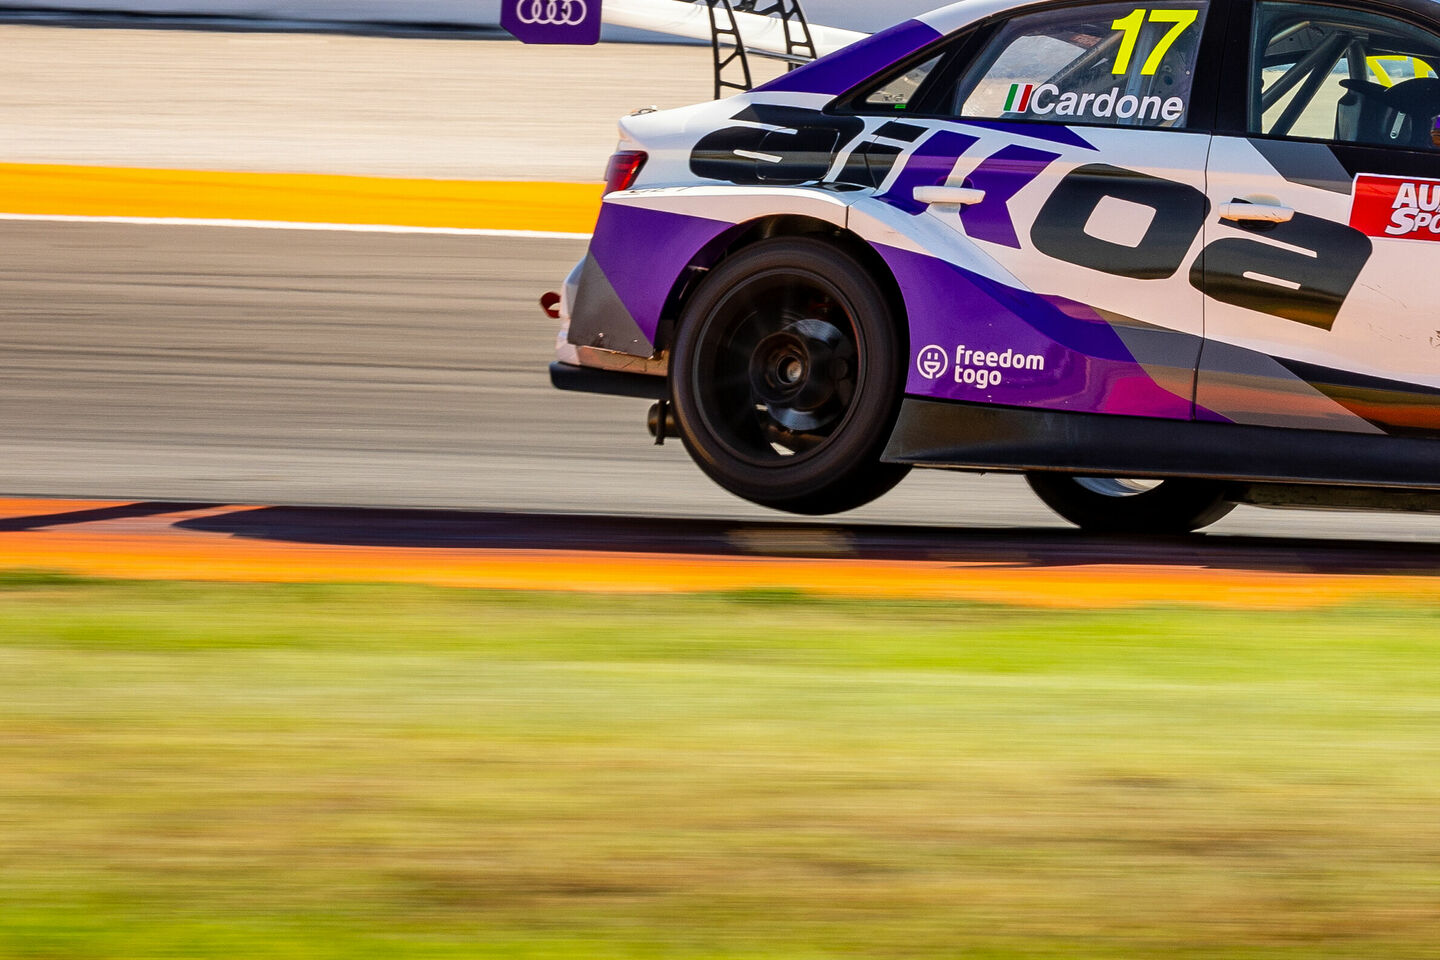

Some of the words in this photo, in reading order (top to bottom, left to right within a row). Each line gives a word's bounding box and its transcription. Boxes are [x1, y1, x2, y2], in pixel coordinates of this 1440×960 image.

[1111, 9, 1199, 75] 17
[1030, 83, 1183, 121] Cardone
[955, 344, 1045, 371] freedom
[954, 365, 1002, 389] togo
